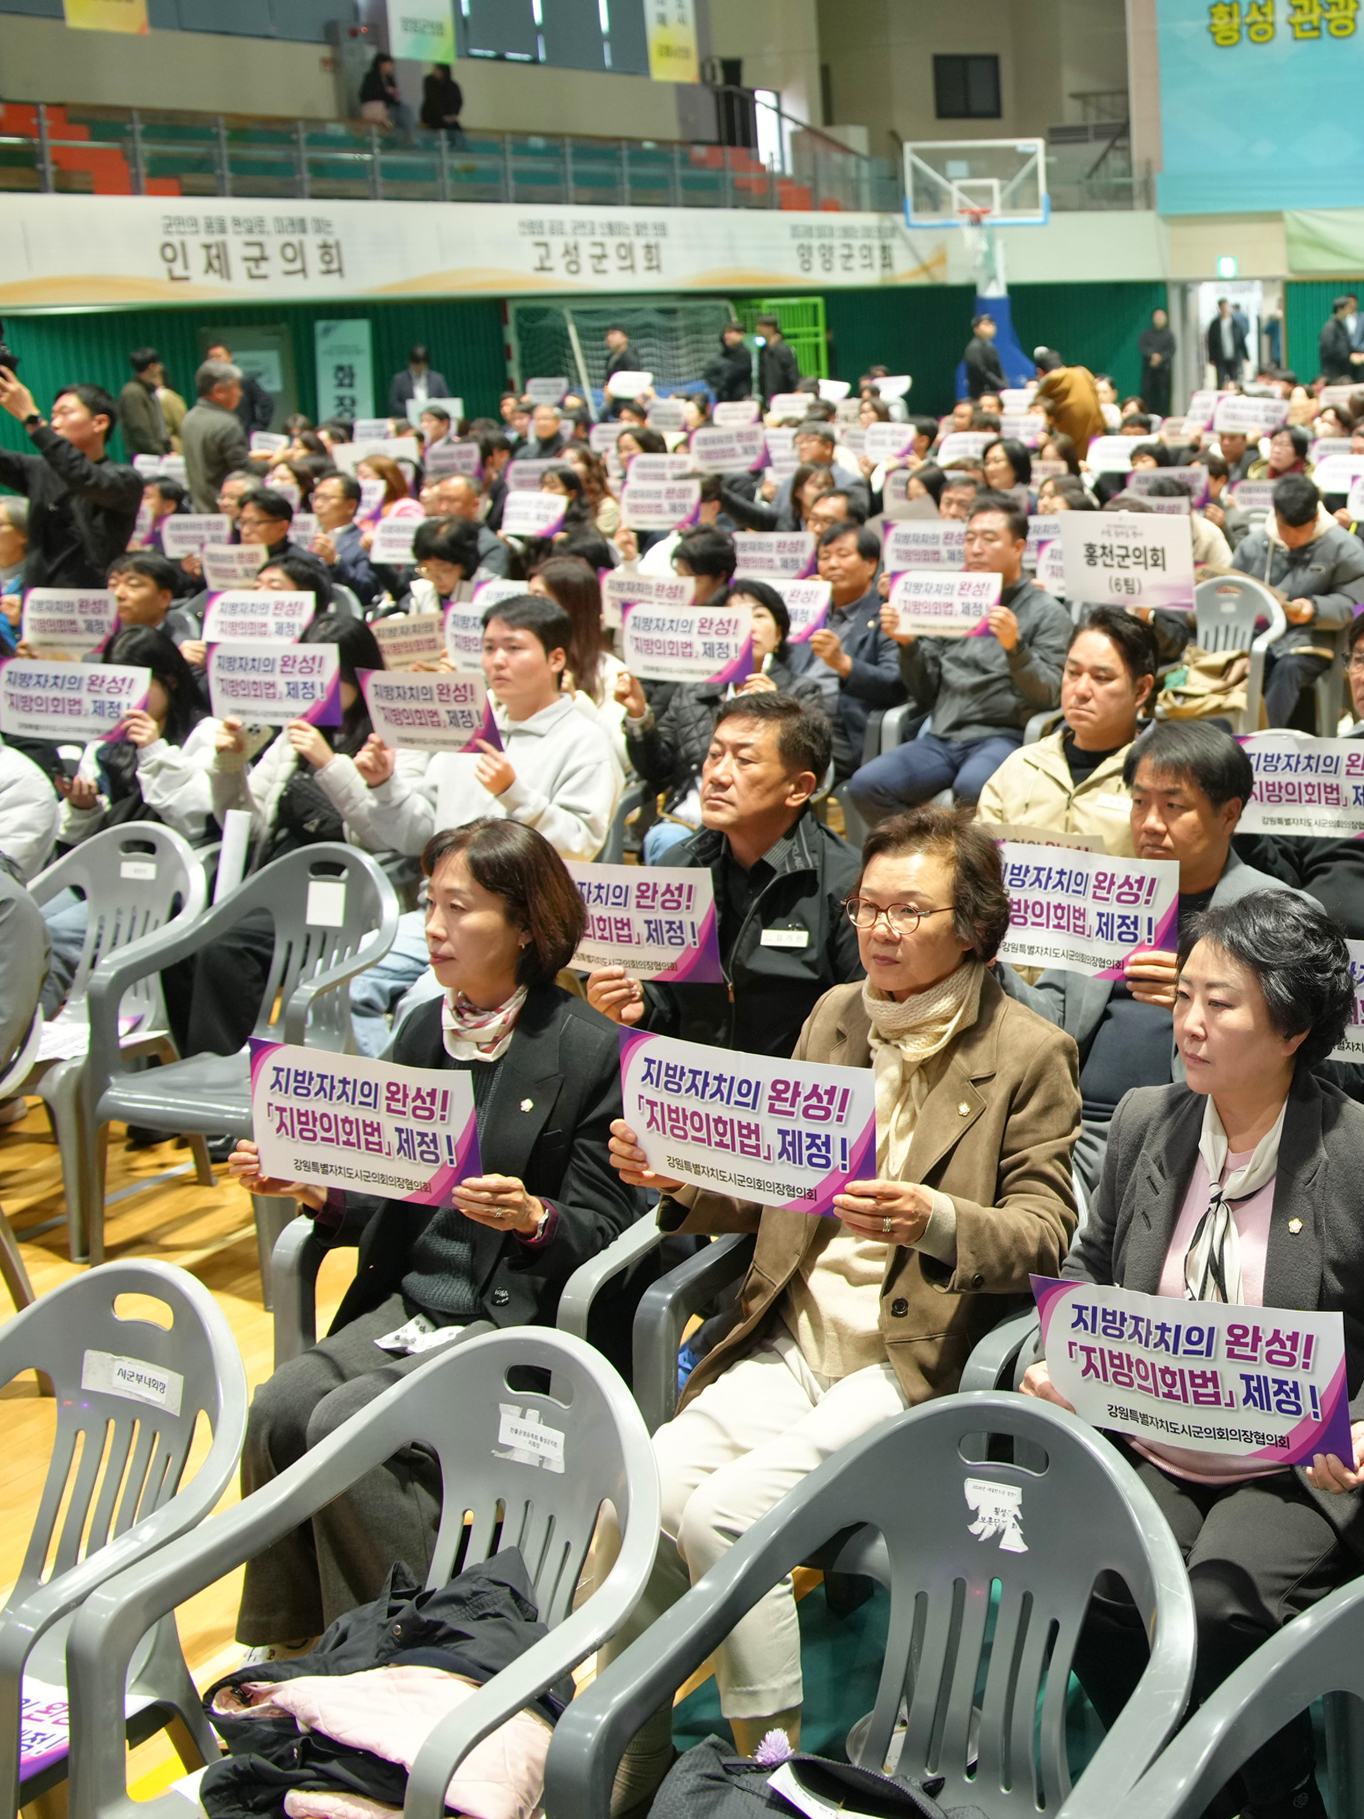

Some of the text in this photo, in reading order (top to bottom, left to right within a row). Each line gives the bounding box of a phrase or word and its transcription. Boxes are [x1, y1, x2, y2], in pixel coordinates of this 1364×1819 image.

[1209, 2, 1275, 46] 횡성
[1289, 0, 1358, 40] 관광
[159, 239, 347, 282] 인제군의회
[532, 240, 664, 275] 고성군의회
[1083, 541, 1167, 571] 홍천군의회
[654, 583, 685, 599] 완성!
[788, 588, 820, 604] 완성!
[902, 581, 991, 597] 지방자치의 완성!
[1109, 576, 1143, 595] (6팀)
[78, 599, 109, 615] 완성!
[217, 600, 304, 617] 지방자치의 완성!
[631, 616, 741, 636] 지방자치의 완성!
[216, 655, 326, 675] 지방자치의 완성!
[5, 670, 135, 695] 지방자치의 완성!
[372, 683, 476, 702] 지방자치의 완성!
[577, 881, 694, 911] 자치의 완성!
[1092, 871, 1157, 905] 완성!
[270, 1066, 450, 1121] 지방자치의 완성!
[641, 1057, 850, 1123] 지방자치의 완성!
[267, 1102, 391, 1157] 「지방의회법」
[638, 1094, 772, 1161] 「지방의회법」
[667, 1155, 817, 1201] 강원특별자치도시군의회의장협의회
[1071, 1304, 1314, 1370] 지방자치의 완성!
[1068, 1341, 1234, 1407] 「지방의회법」
[1107, 1404, 1290, 1449] 강원특별자치도시군의회의장협의회
